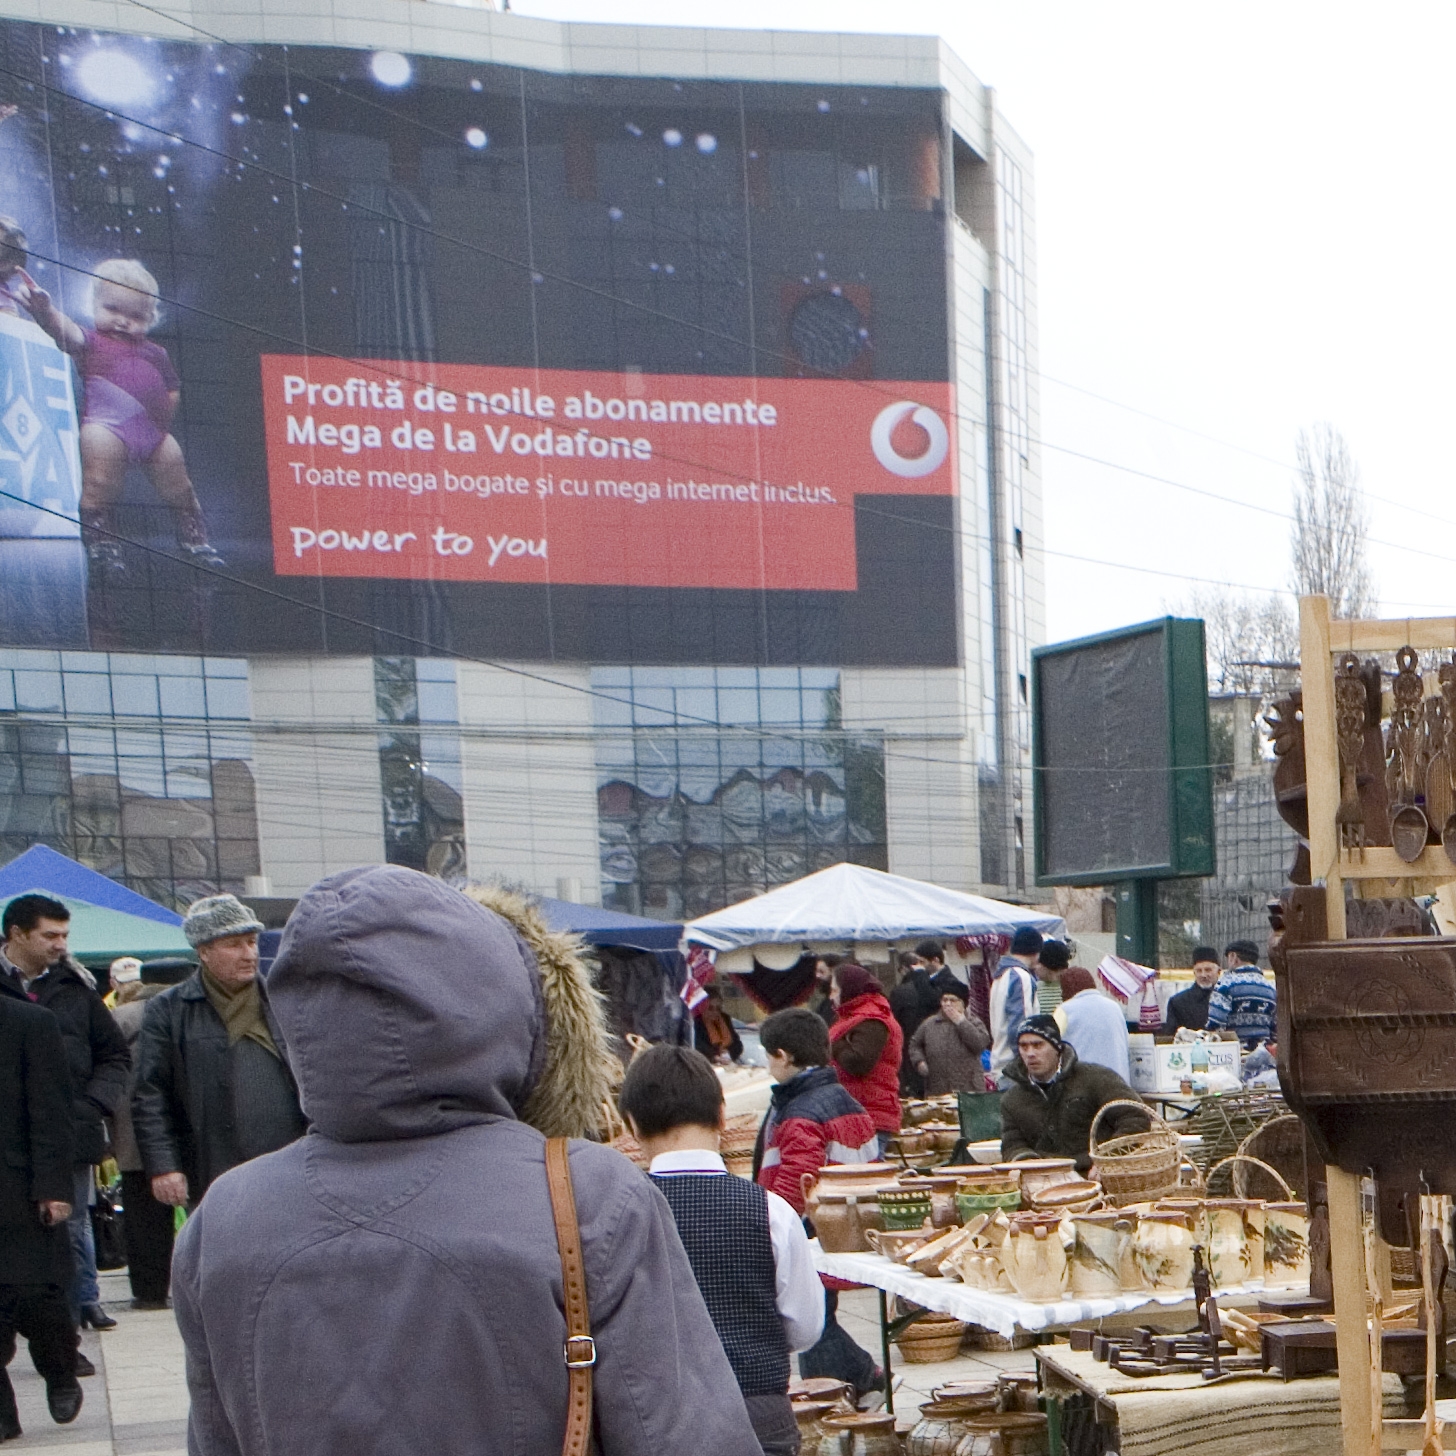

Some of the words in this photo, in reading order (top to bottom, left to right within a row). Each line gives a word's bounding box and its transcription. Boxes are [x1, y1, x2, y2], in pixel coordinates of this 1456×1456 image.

[283, 374, 405, 410] Profită
[413, 382, 458, 413] de
[466, 386, 556, 418] noile
[563, 390, 779, 427] abonamente
[286, 414, 382, 455] Mega
[390, 419, 436, 451] de
[443, 422, 477, 453] la
[484, 424, 653, 460] Vodafone
[288, 461, 362, 488] Toate
[367, 469, 438, 496] mega
[444, 468, 530, 498] bogate
[560, 478, 589, 497] cu
[594, 479, 662, 504] mega
[666, 477, 760, 502] internet
[763, 481, 838, 504] inclus.
[289, 526, 418, 558] power
[432, 525, 474, 556] to
[486, 533, 549, 568] you
